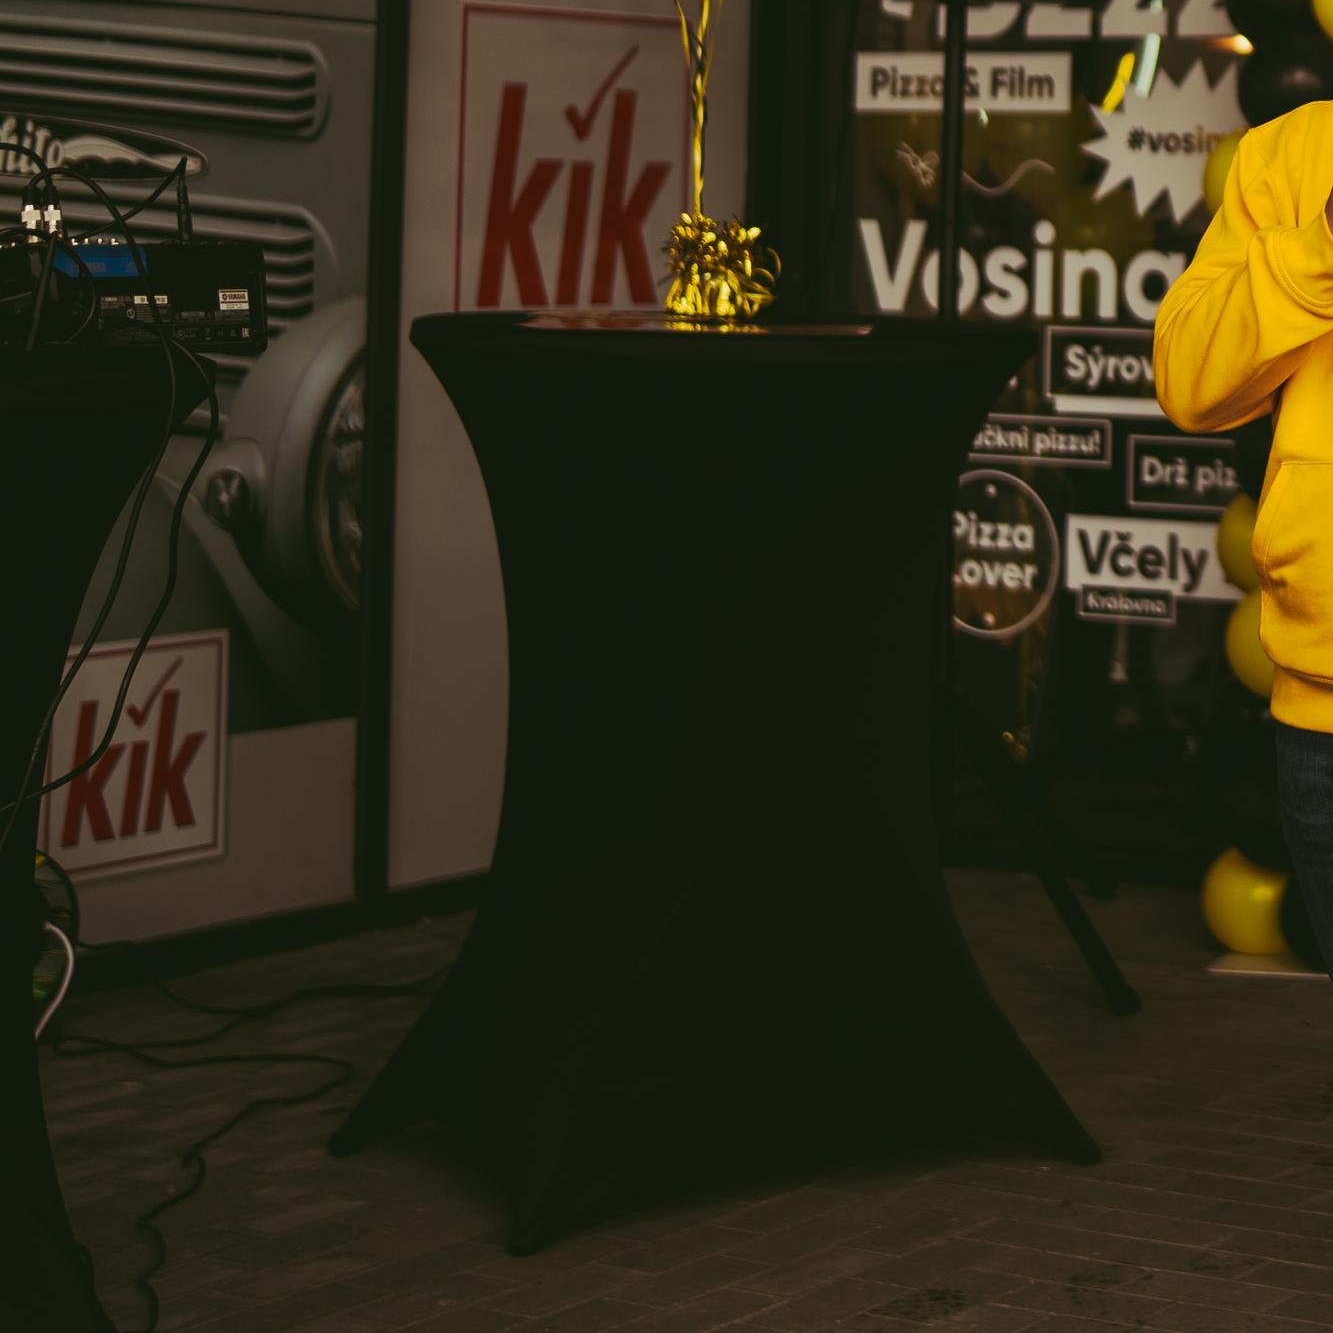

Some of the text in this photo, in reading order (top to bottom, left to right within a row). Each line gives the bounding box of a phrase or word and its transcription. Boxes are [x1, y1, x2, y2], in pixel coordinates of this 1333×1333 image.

[870, 65, 944, 99] Pizza
[991, 64, 1055, 100] Film
[1034, 425, 1100, 457] pizzu!
[1142, 455, 1189, 487] Drž
[1076, 529, 1209, 593] Včely
